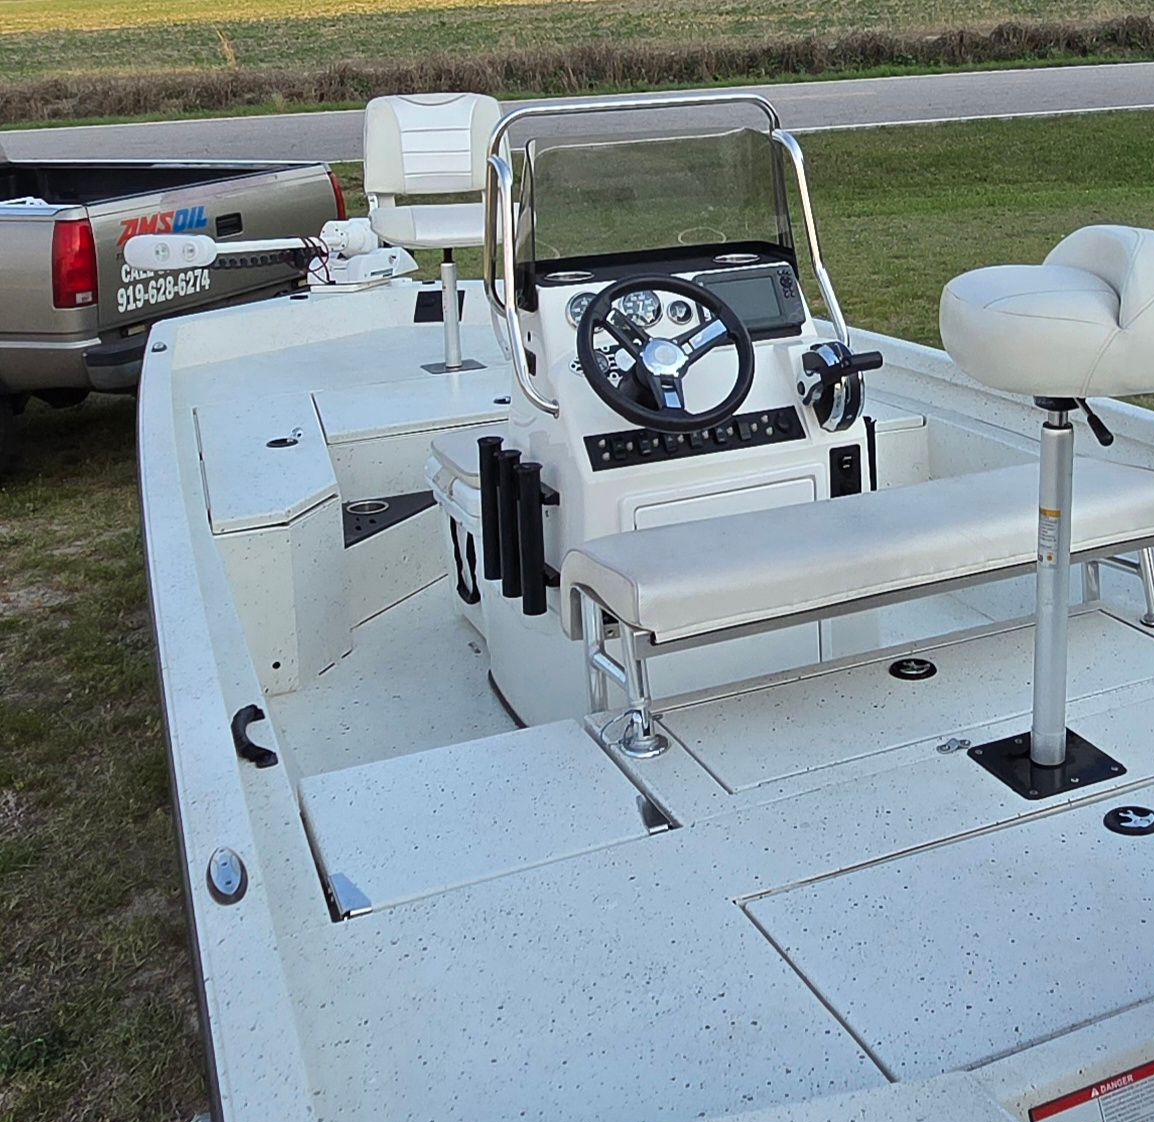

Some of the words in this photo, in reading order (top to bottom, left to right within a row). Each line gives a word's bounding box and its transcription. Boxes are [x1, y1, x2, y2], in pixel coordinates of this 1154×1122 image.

[117, 206, 208, 246] AMSOIL
[117, 269, 210, 313] 919-628-6274
[1100, 1074, 1134, 1094] DANGER
